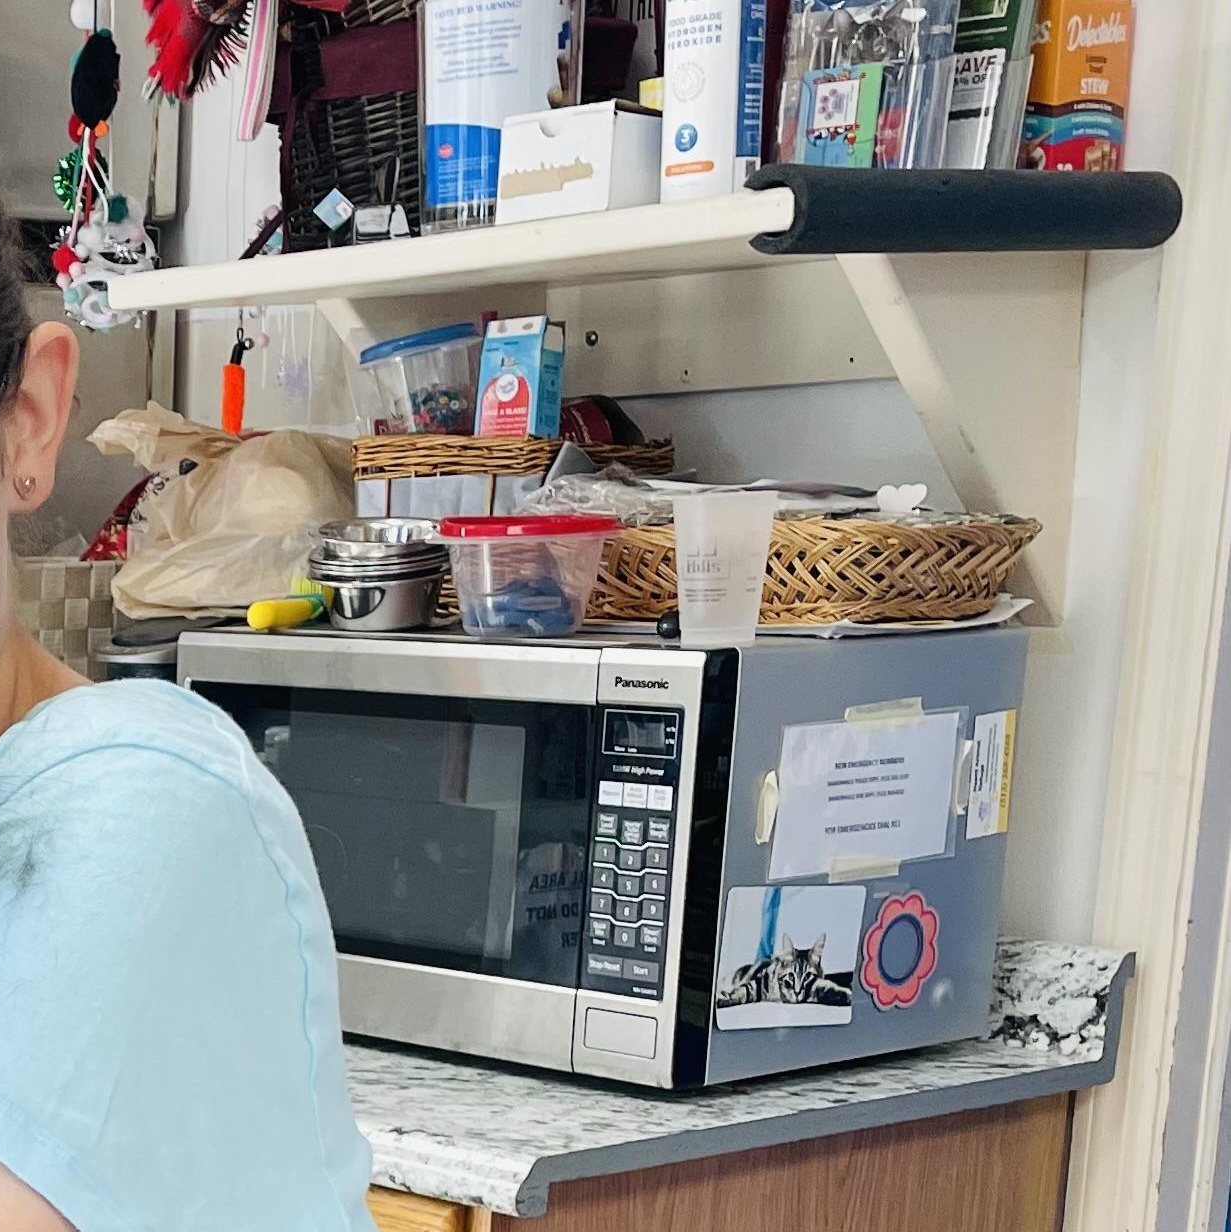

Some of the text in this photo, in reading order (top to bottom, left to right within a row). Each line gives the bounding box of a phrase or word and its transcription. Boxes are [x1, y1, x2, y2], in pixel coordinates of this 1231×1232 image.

[689, 11, 722, 24] GRADE
[1066, 12, 1129, 52] Delectables
[1079, 76, 1110, 95] STEW
[614, 676, 670, 690] Panasonic
[633, 965, 649, 976] Start
